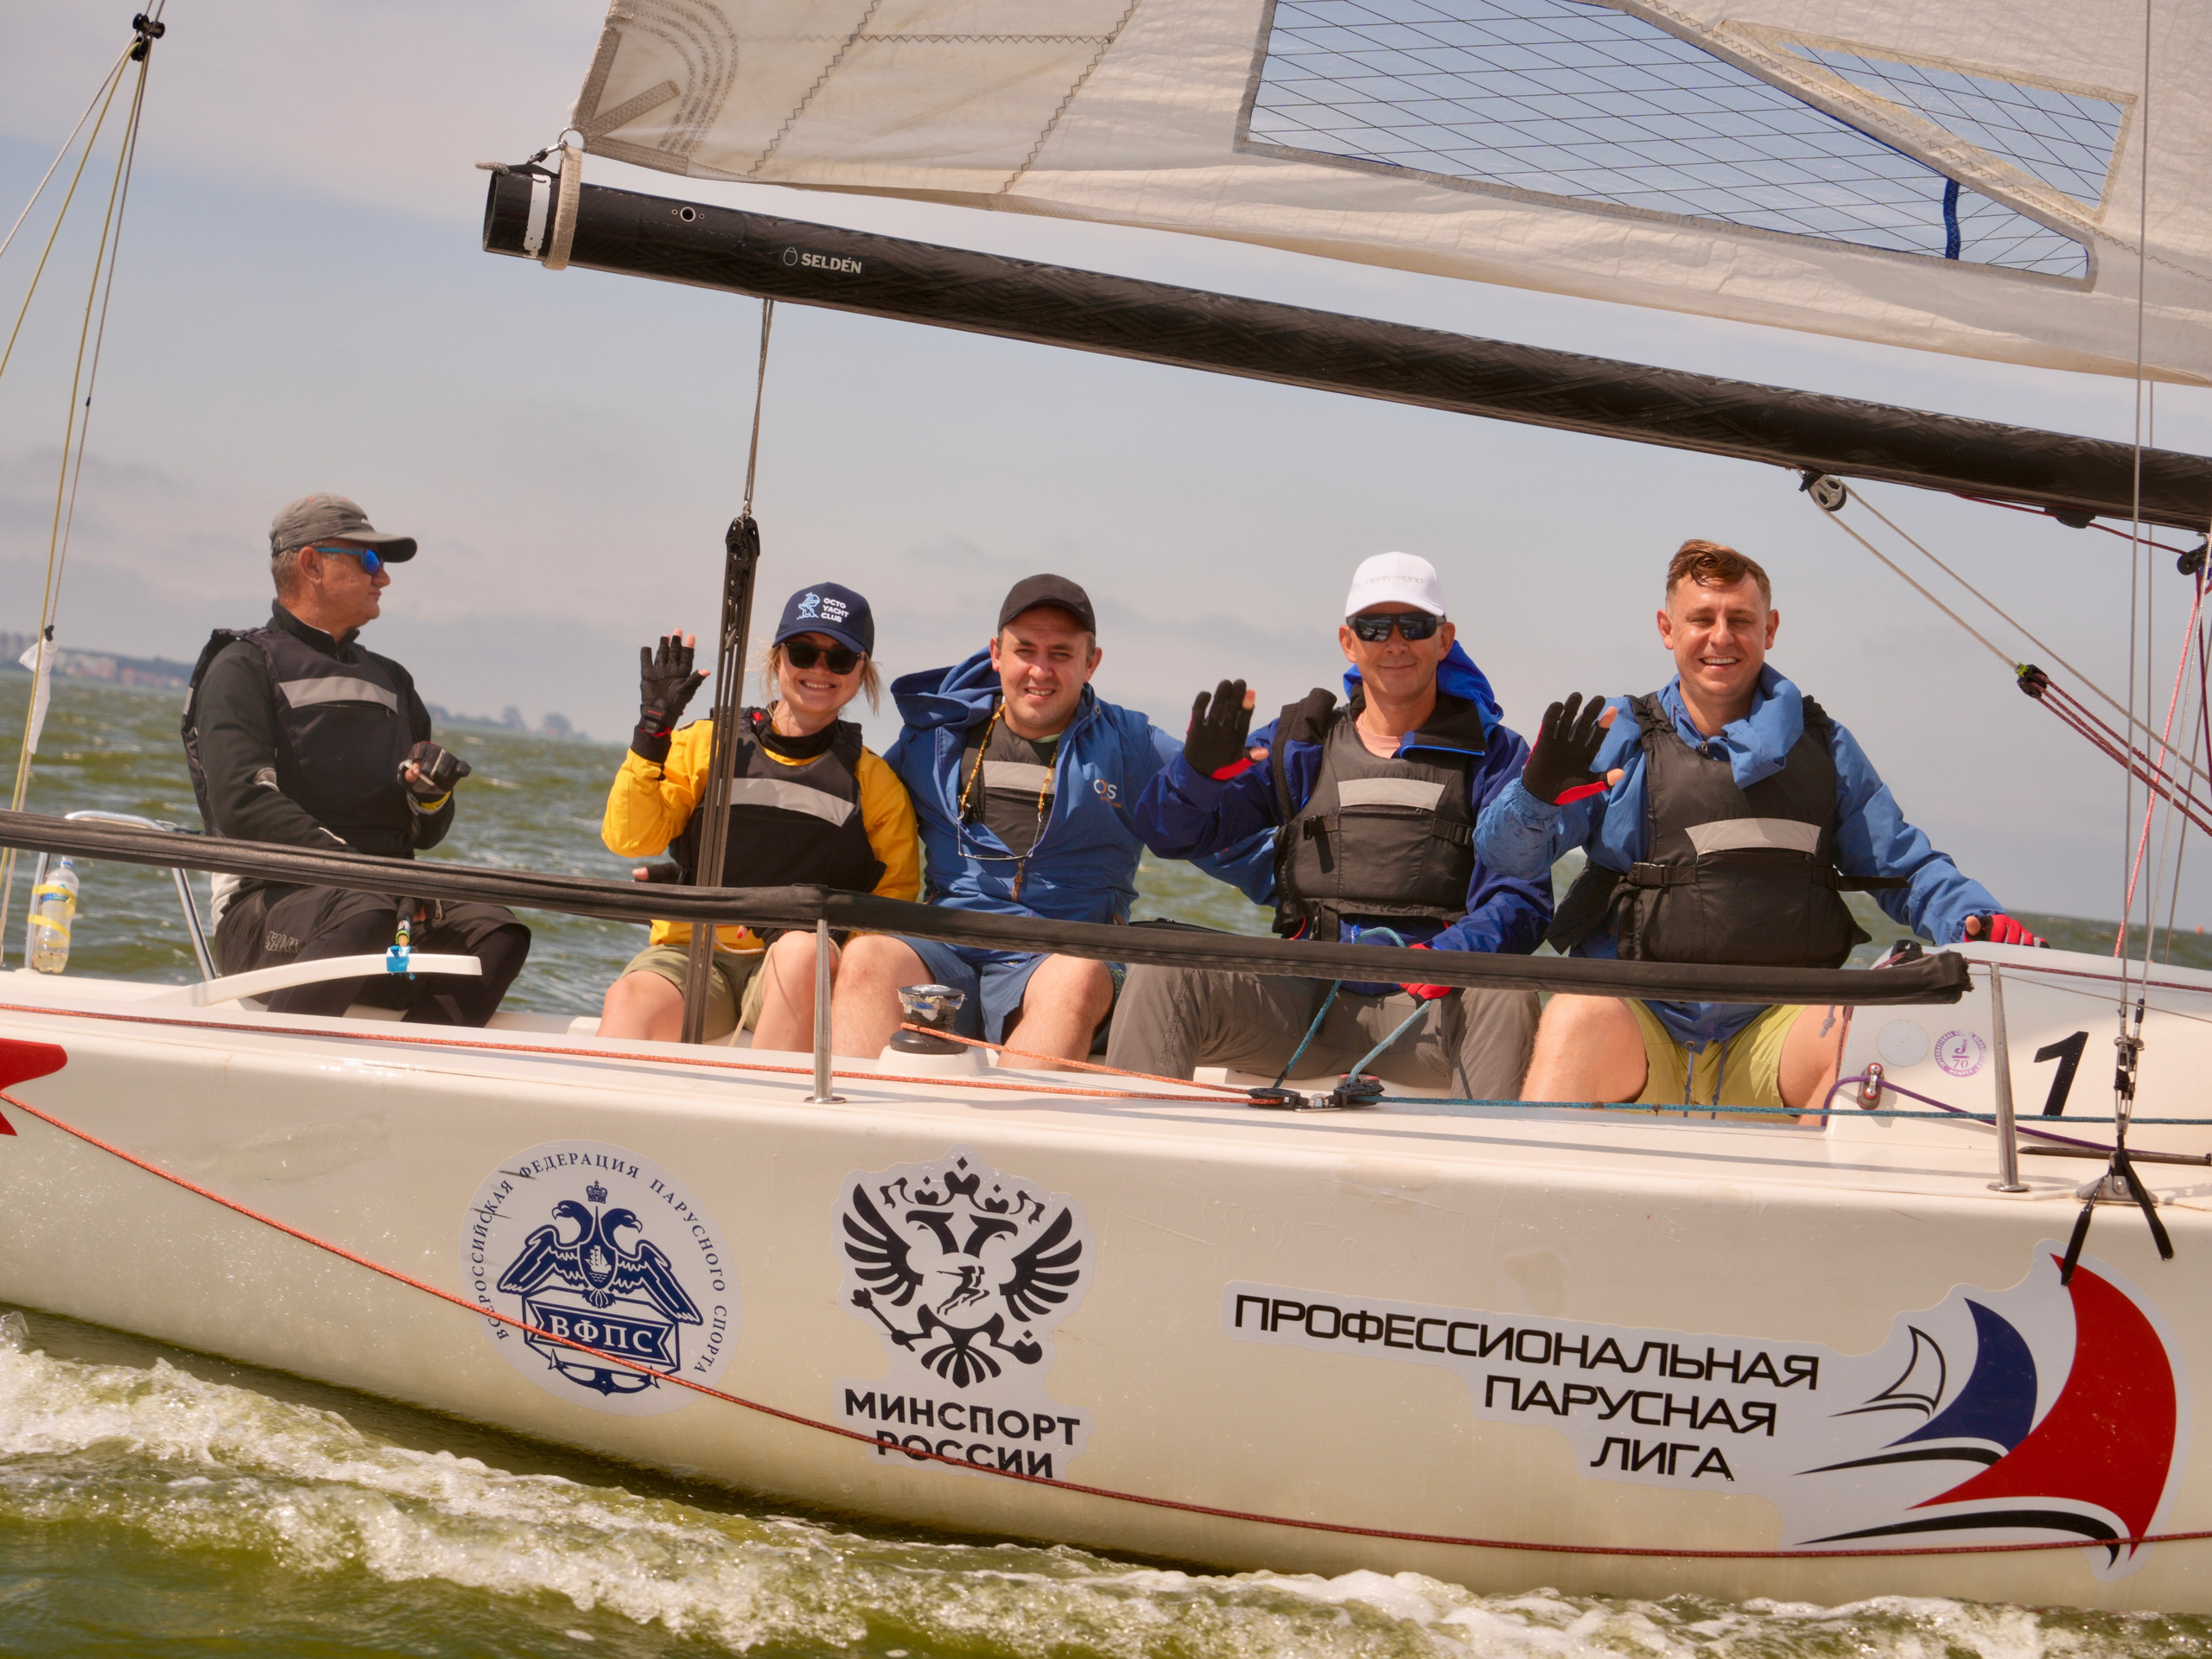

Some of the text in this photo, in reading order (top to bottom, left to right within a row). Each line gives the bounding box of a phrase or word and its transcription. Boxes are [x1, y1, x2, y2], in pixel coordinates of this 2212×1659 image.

[801, 253, 861, 274] SELDÉN
[821, 613, 842, 622] CLUB
[823, 598, 846, 608] OCTO
[823, 606, 849, 618] YACHT
[1953, 1058, 1969, 1069] 70
[2033, 1031, 2089, 1116] 1
[518, 1152, 640, 1179] ФЕДЕРАЦИЯ
[650, 1178, 726, 1292] ПАРУСНОГО
[694, 1305, 728, 1374] СПОРТА
[549, 1314, 655, 1353] ВФПС
[1234, 1294, 1820, 1391] ПРОФЕССИОНАЛЬНАЯ
[844, 1388, 1081, 1446] МИНСПОРТ
[1484, 1374, 1777, 1437] ПАРУСНАЯ
[875, 1429, 1053, 1479] РОССИИ
[1589, 1436, 1735, 1482] ЛИГА
